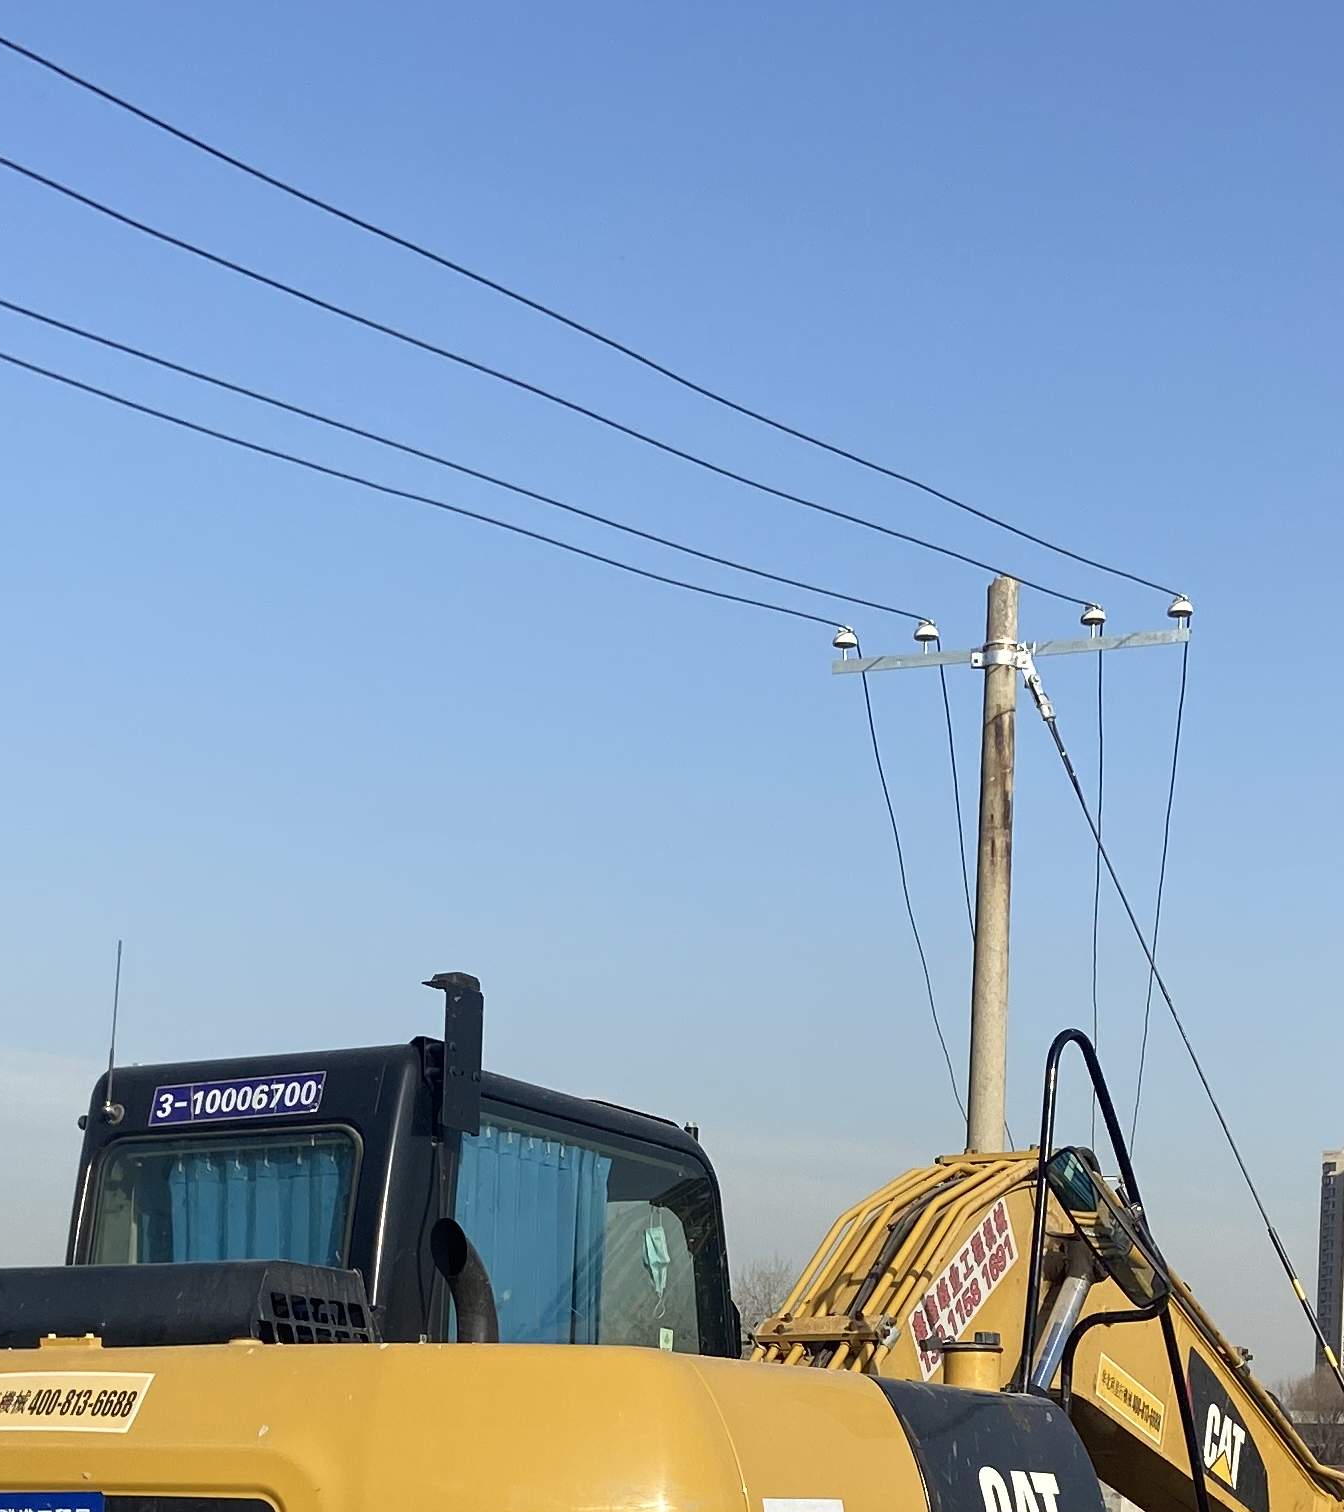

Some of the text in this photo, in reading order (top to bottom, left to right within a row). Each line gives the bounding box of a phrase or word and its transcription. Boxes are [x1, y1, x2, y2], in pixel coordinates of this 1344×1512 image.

[155, 1080, 317, 1118] 3-10006700
[28, 1389, 138, 1418] 400-813-6688
[1203, 1403, 1246, 1490] CAT
